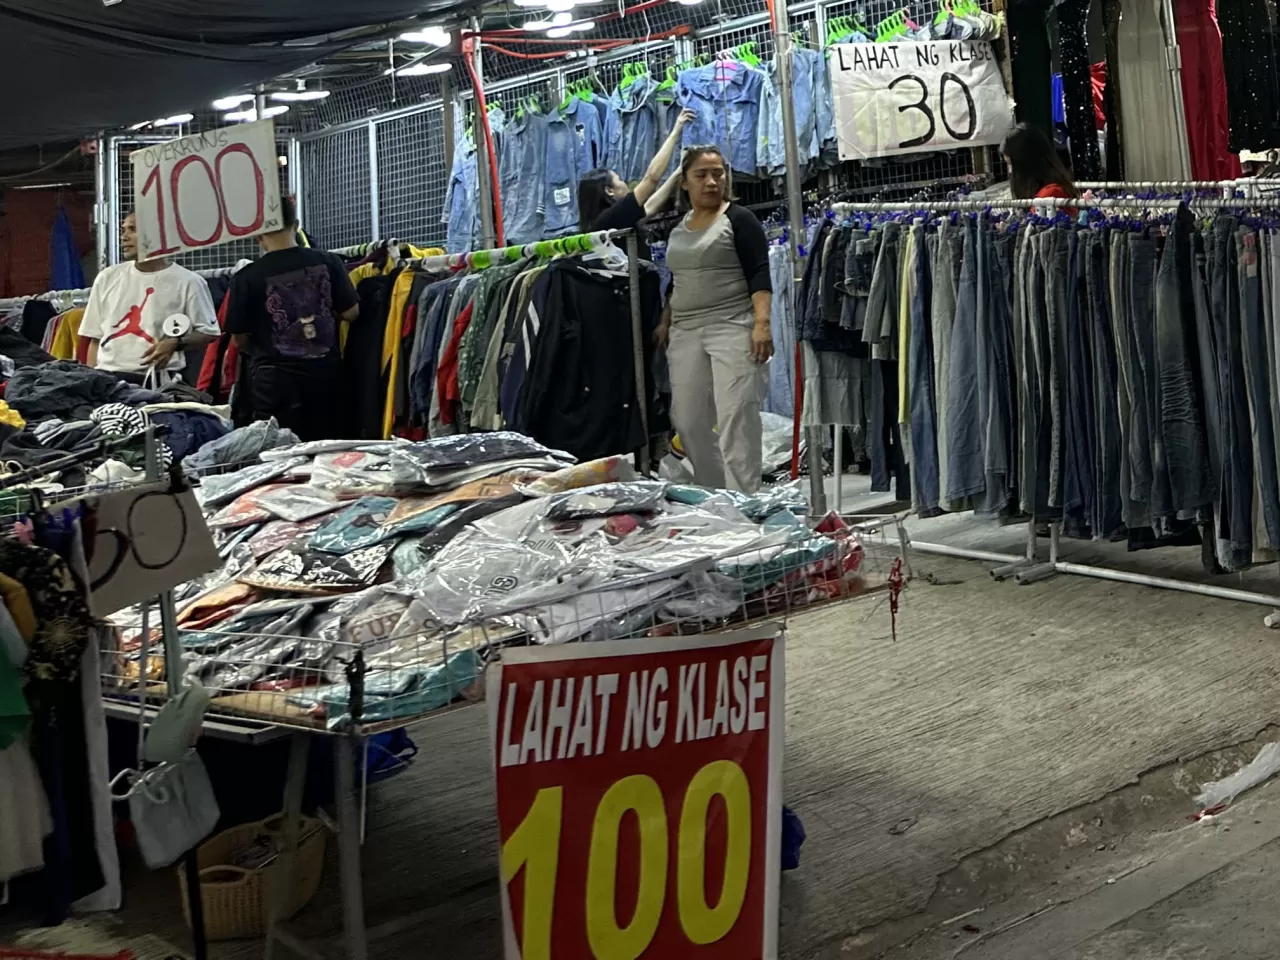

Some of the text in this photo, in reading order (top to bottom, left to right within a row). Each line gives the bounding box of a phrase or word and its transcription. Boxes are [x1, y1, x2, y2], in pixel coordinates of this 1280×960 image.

[838, 41, 993, 72] LAHAT NG KLASE
[144, 130, 228, 168] OVERRUNS
[888, 72, 977, 148] 30
[141, 143, 264, 258] 100
[501, 655, 767, 767] LAHAT NG KLASE
[503, 760, 751, 960] 100
